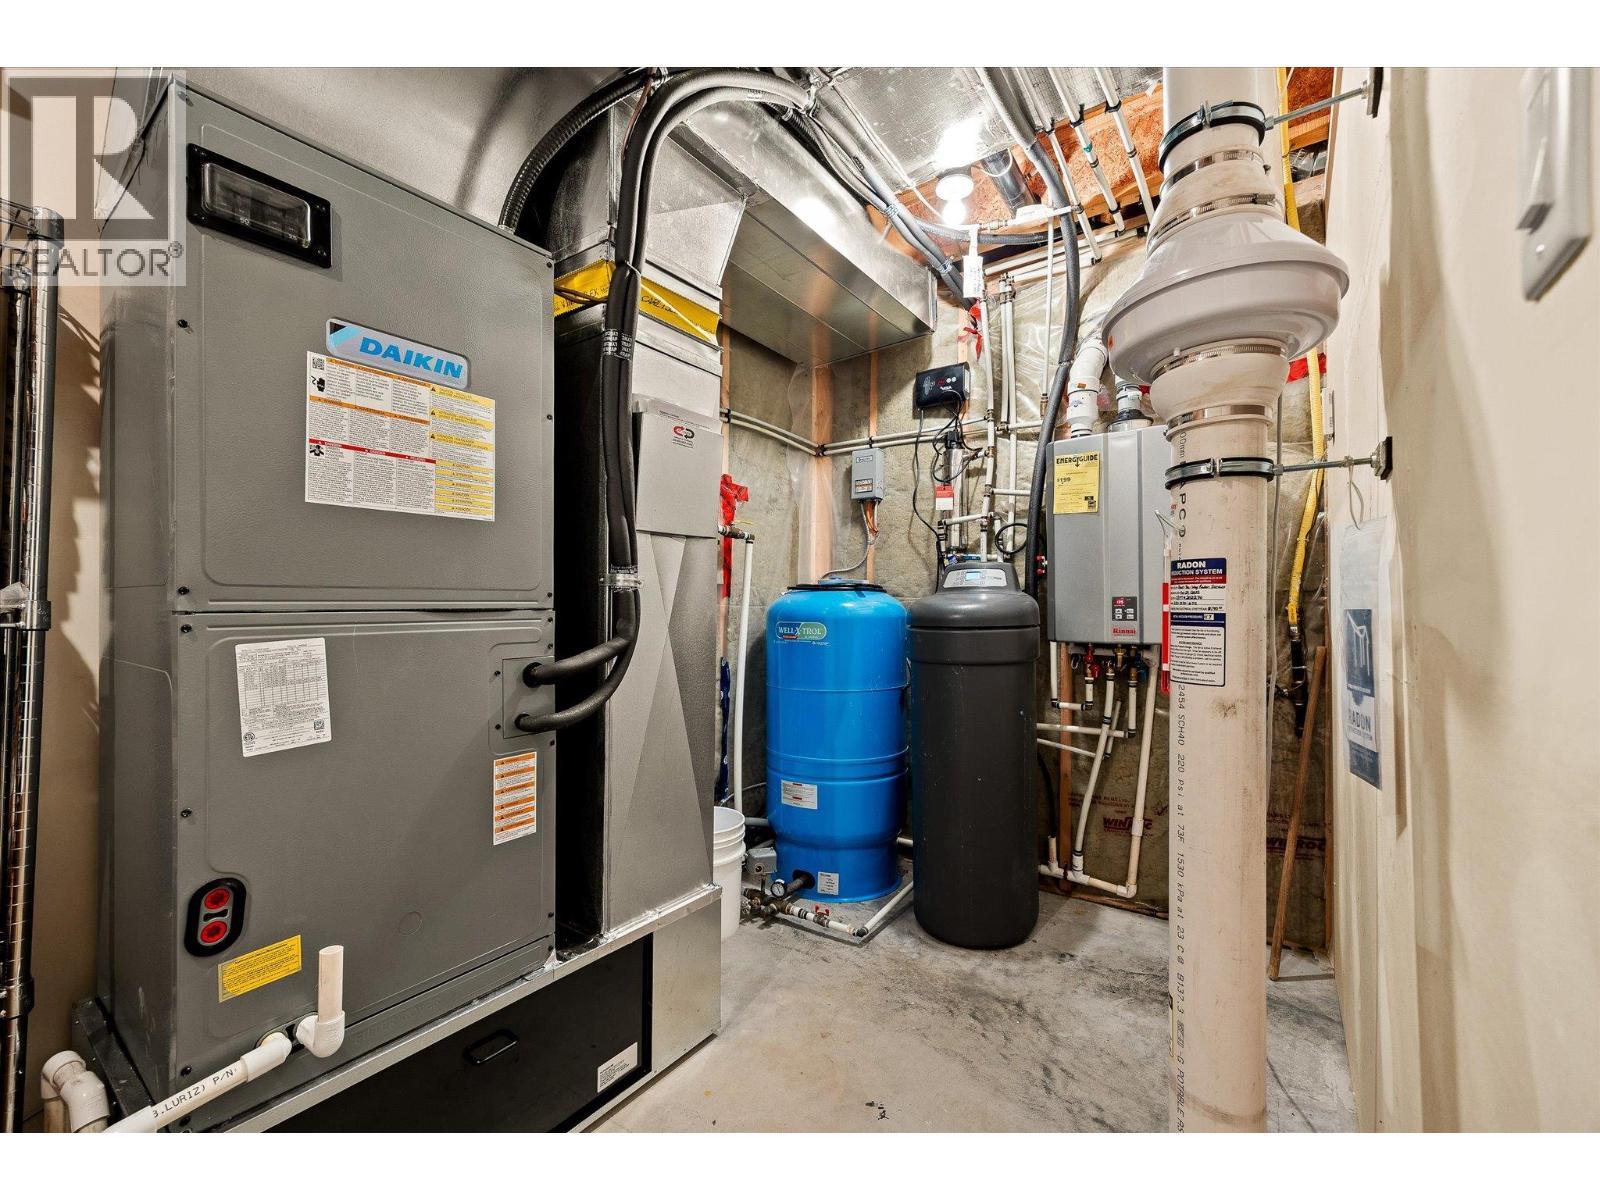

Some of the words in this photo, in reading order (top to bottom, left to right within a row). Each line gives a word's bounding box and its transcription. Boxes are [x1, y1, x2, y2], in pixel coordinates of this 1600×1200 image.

[359, 336, 463, 379] DAIKIN
[1176, 561, 1206, 569] RADON
[1177, 714, 1185, 746] SCH40
[1177, 753, 1185, 773] 220
[1177, 825, 1185, 843] 73F
[1177, 852, 1185, 878] 1530
[1177, 925, 1184, 940] 23
[1177, 1069, 1185, 1118] POTABLE
